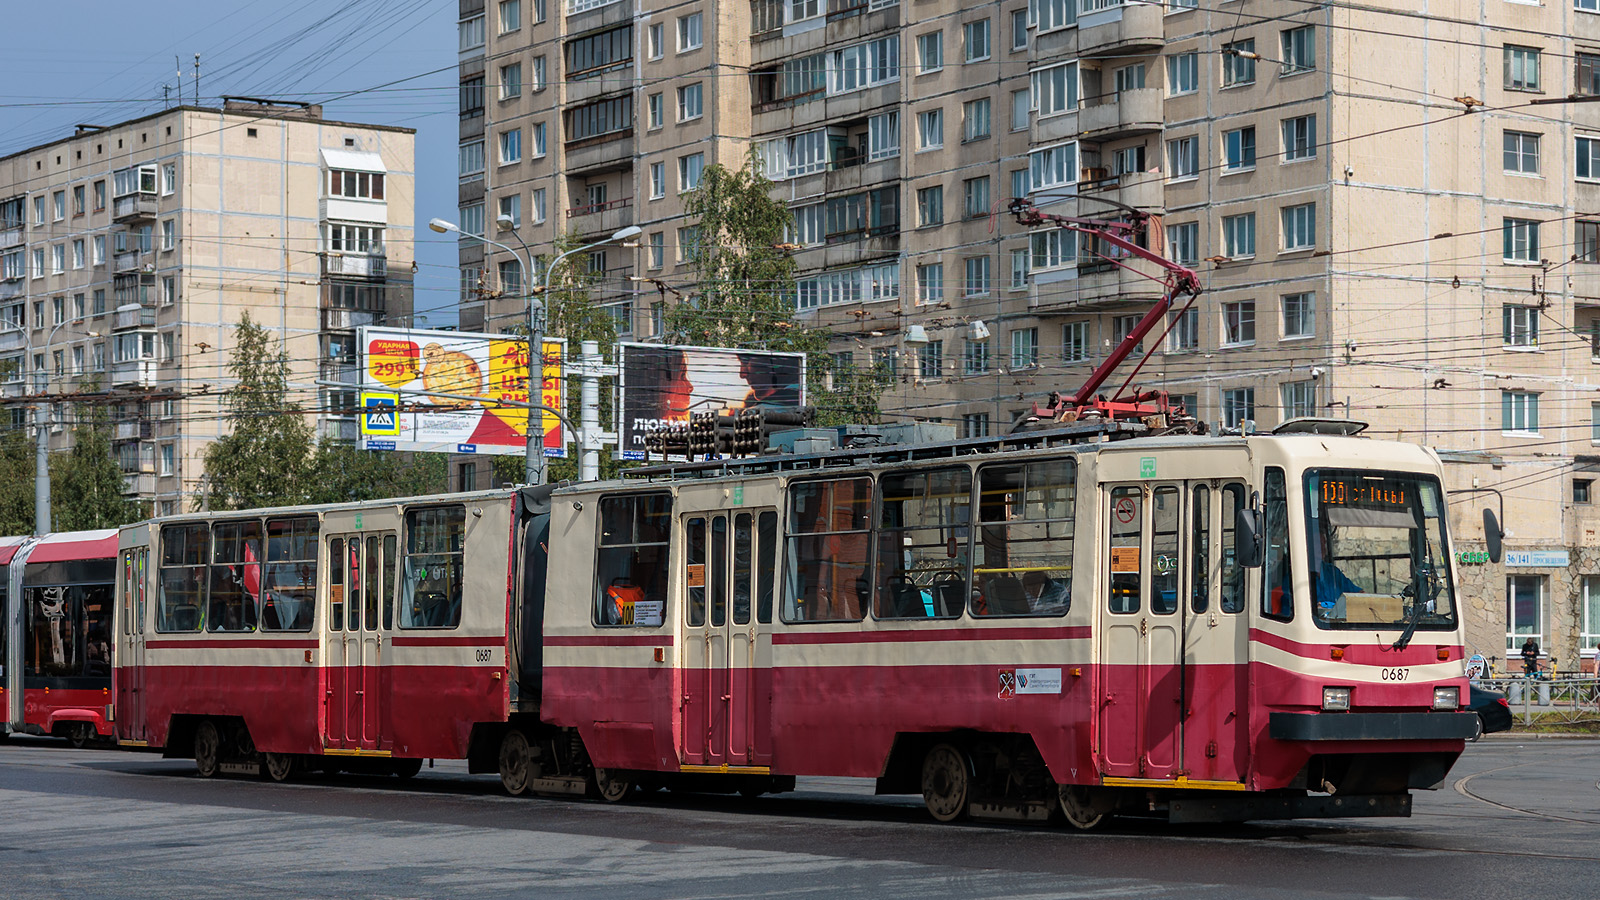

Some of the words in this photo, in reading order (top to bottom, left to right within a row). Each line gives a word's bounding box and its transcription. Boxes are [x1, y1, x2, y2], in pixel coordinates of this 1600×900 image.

[378, 342, 410, 350] УДАРНАЯ
[502, 375, 559, 392] ЦЕЫ
[1461, 552, 1490, 562] СБЕР
[1506, 554, 1530, 564] 36/141
[476, 649, 491, 662] 0687
[1381, 668, 1409, 681] 0687
